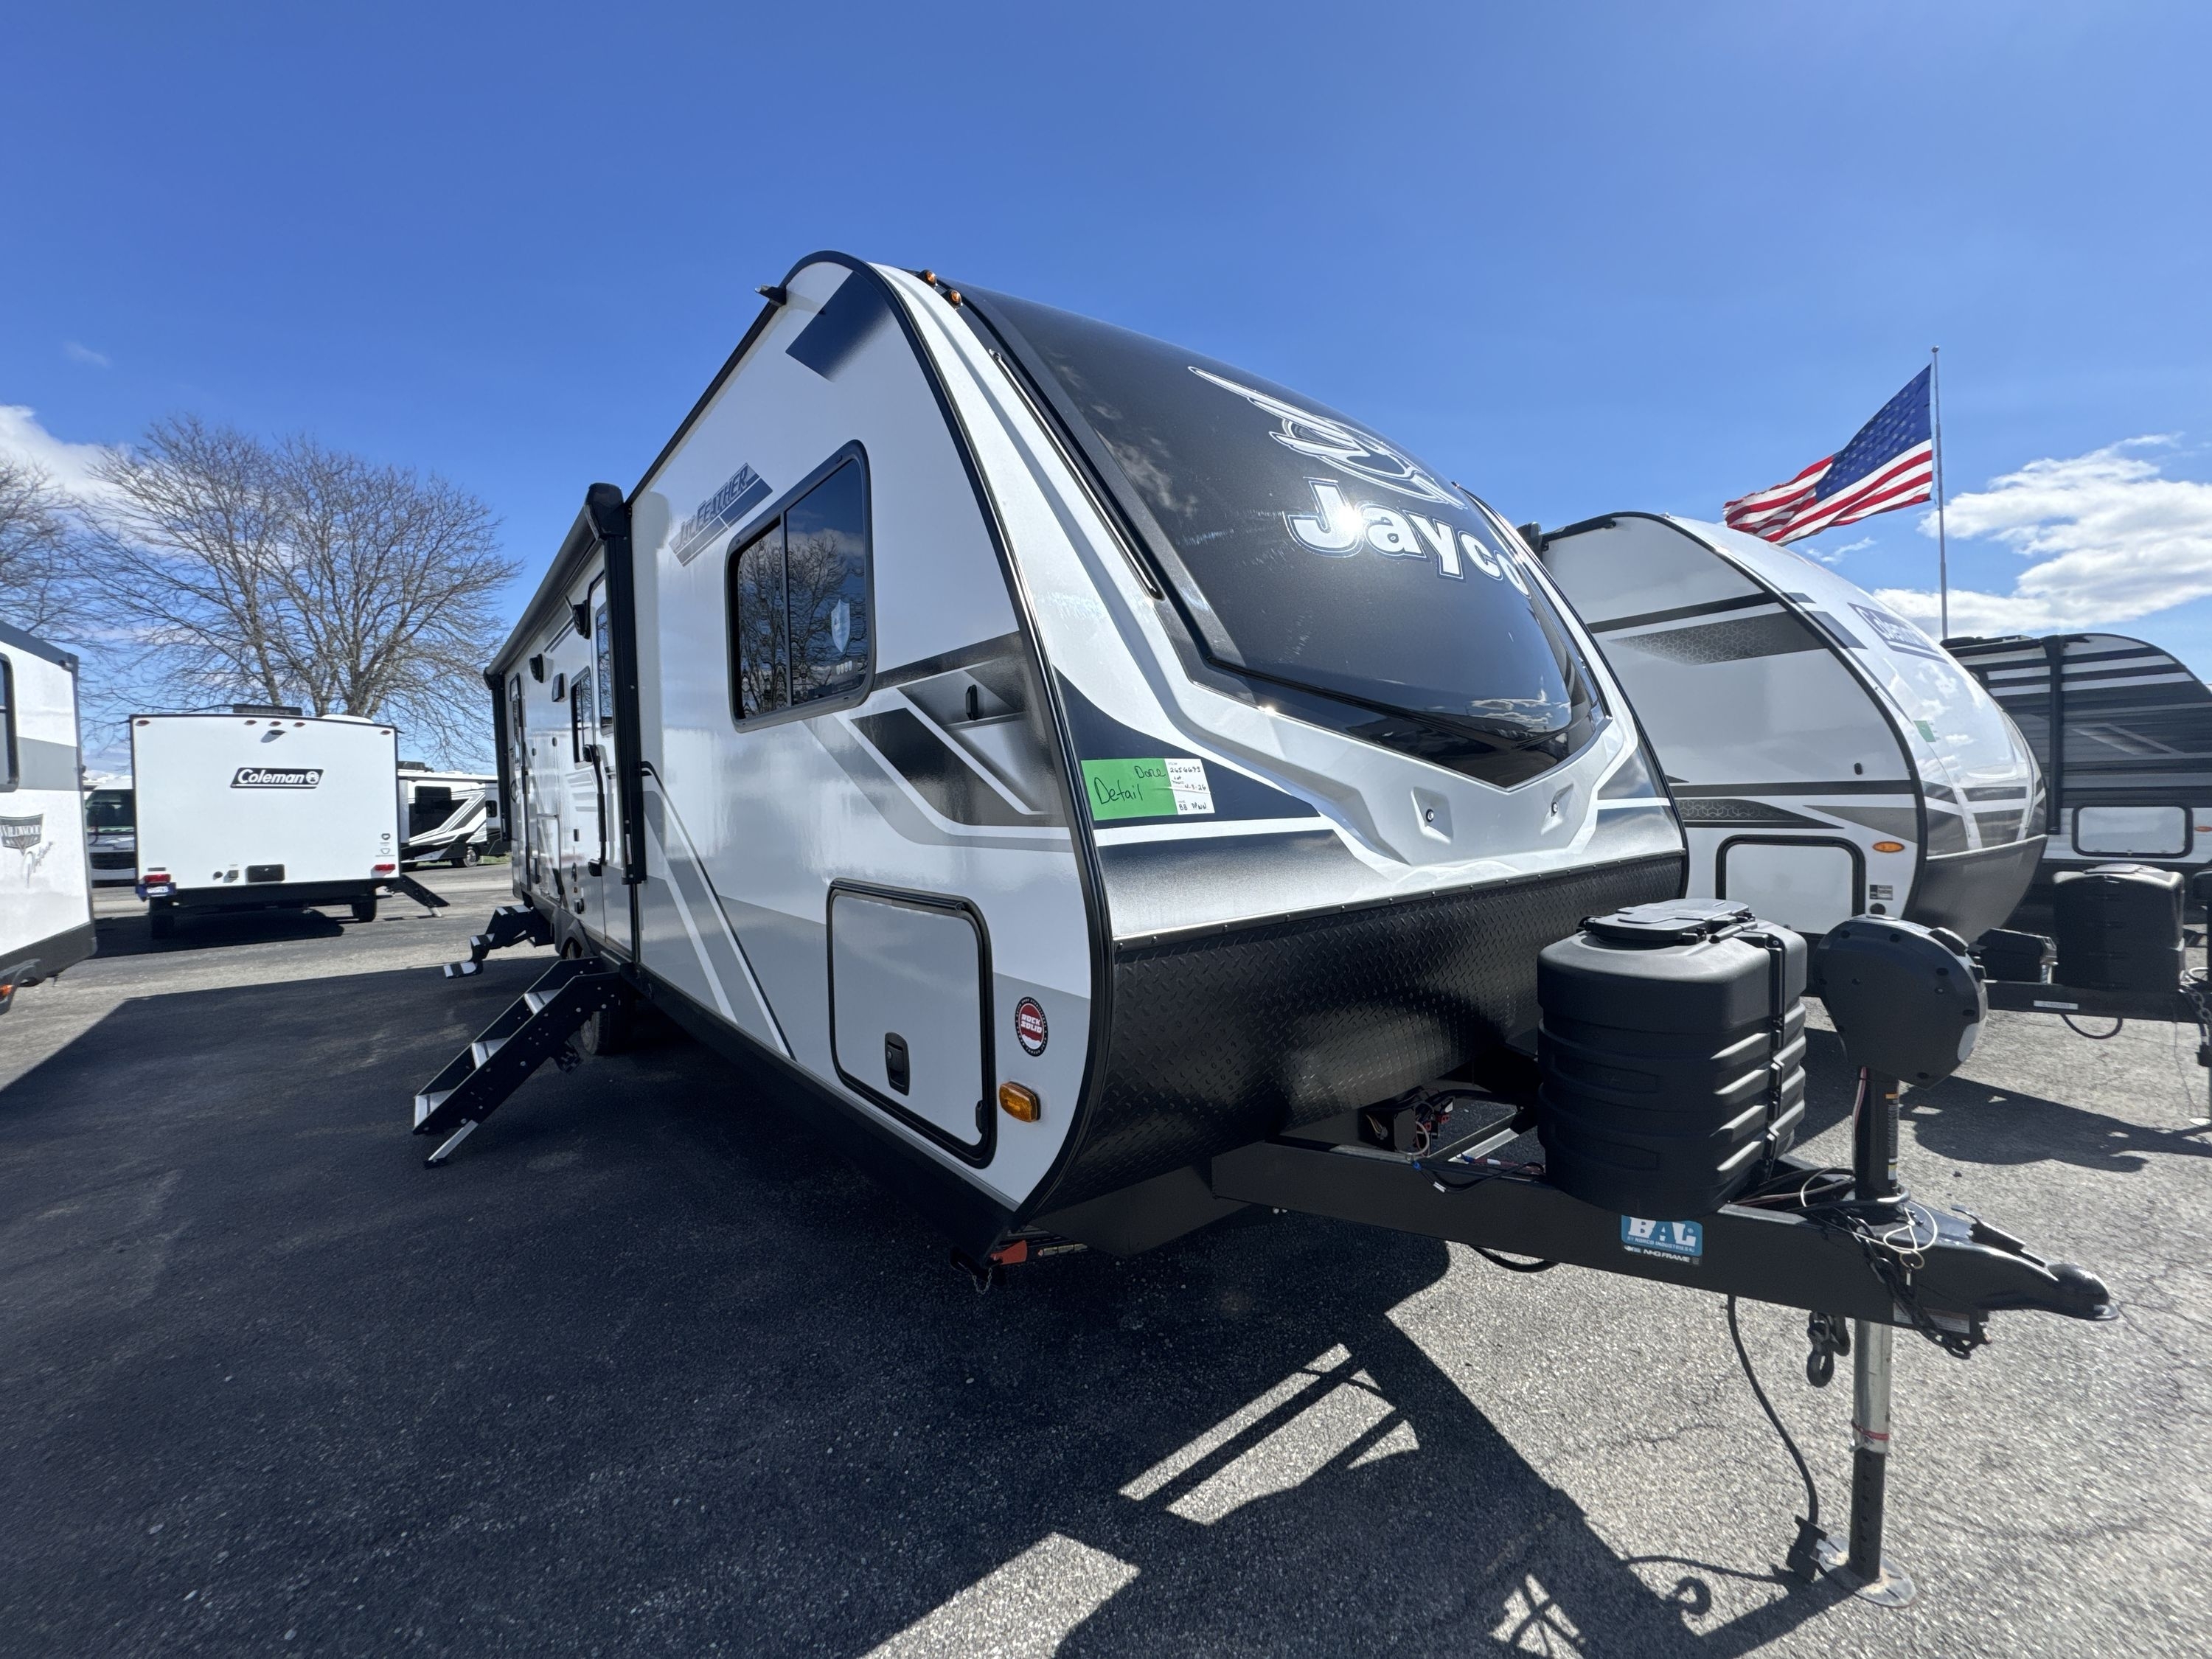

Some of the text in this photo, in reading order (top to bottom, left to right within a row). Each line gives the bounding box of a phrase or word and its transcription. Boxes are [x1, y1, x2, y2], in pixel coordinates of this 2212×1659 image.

[695, 464, 749, 530] FEATHER
[1283, 477, 1531, 599] Jayco
[237, 768, 305, 784] Coleman
[1134, 765, 1166, 779] Done
[1093, 776, 1144, 805] Detail
[1021, 1013, 1041, 1026] ROCK
[1020, 1020, 1043, 1034] SOLID
[1655, 1241, 1688, 1251] INDUSTRIES
[1661, 1253, 1690, 1262] FRAME
